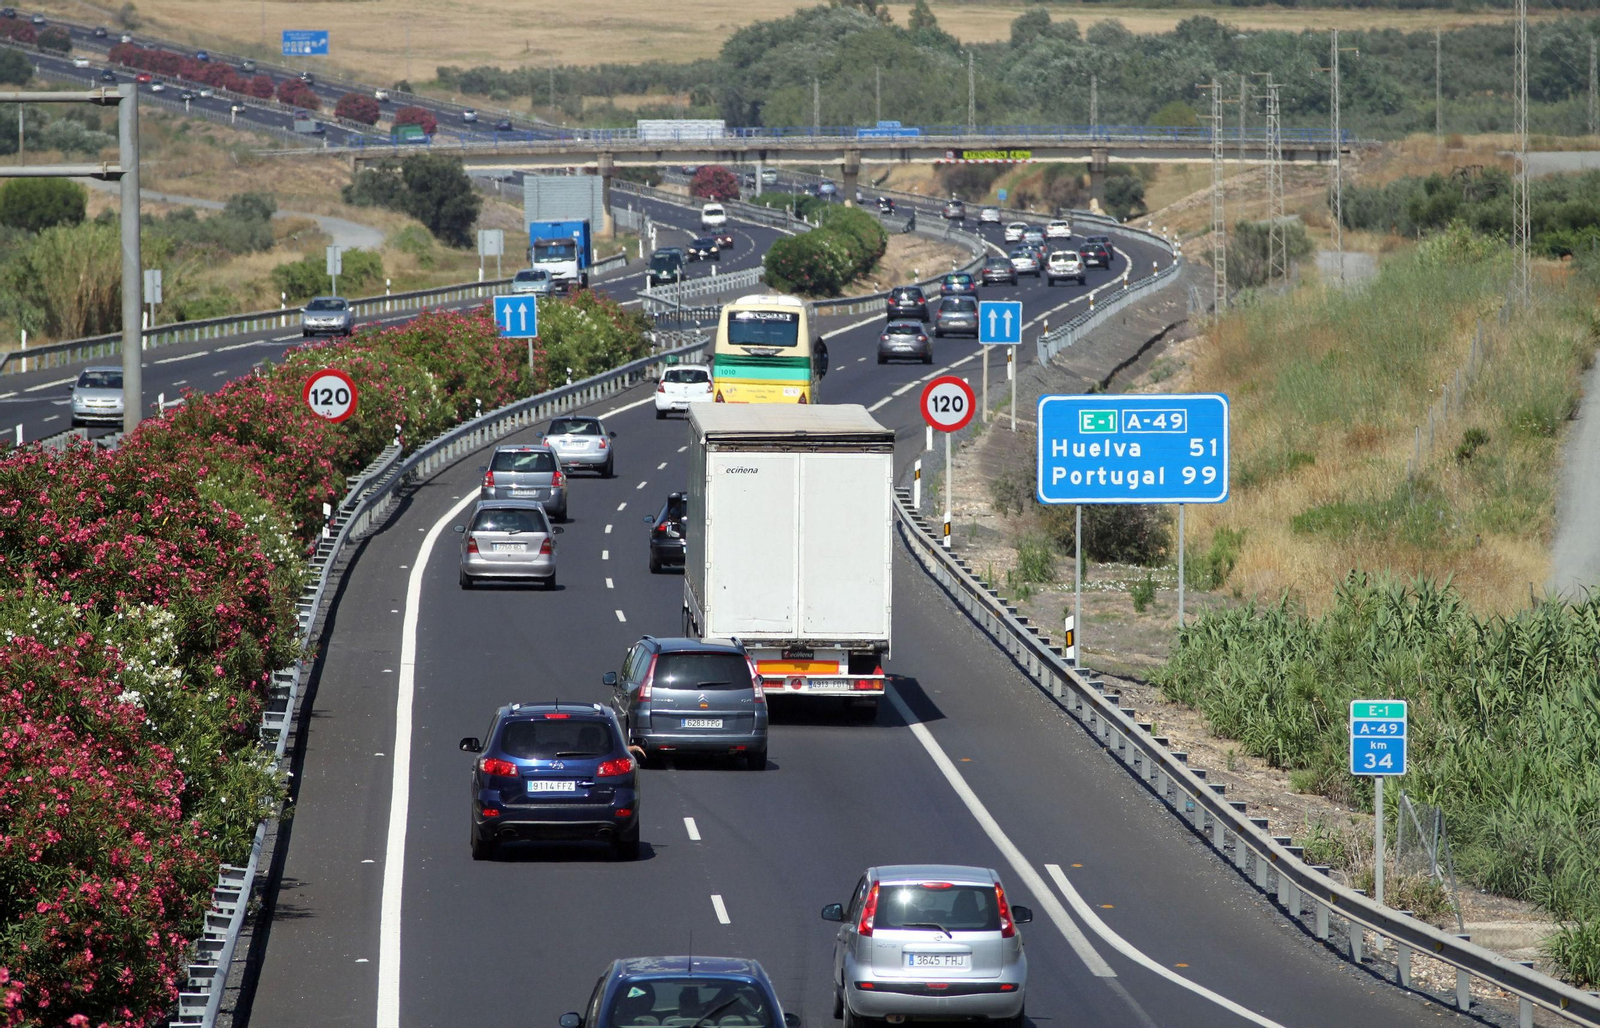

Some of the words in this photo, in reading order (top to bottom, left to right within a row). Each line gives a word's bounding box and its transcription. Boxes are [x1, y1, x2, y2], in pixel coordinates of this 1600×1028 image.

[311, 388, 350, 406] 120
[932, 395, 964, 413] 120
[1083, 414, 1114, 429] E-1
[1127, 413, 1183, 429] A-49
[1052, 439, 1141, 457] Huelva
[1189, 438, 1217, 457] 51
[1052, 466, 1165, 489] Portugal
[1181, 465, 1217, 485] 99
[812, 680, 829, 688] 4913
[1369, 705, 1389, 717] E-1
[687, 719, 705, 727] 6283
[706, 719, 721, 727] FPG
[1360, 723, 1398, 735] A-49
[1370, 741, 1387, 749] km
[1363, 753, 1393, 768] 34
[533, 782, 555, 790] 9114
[556, 782, 573, 791] FFZ
[917, 955, 940, 966] 3645
[945, 955, 964, 966] FHJ
